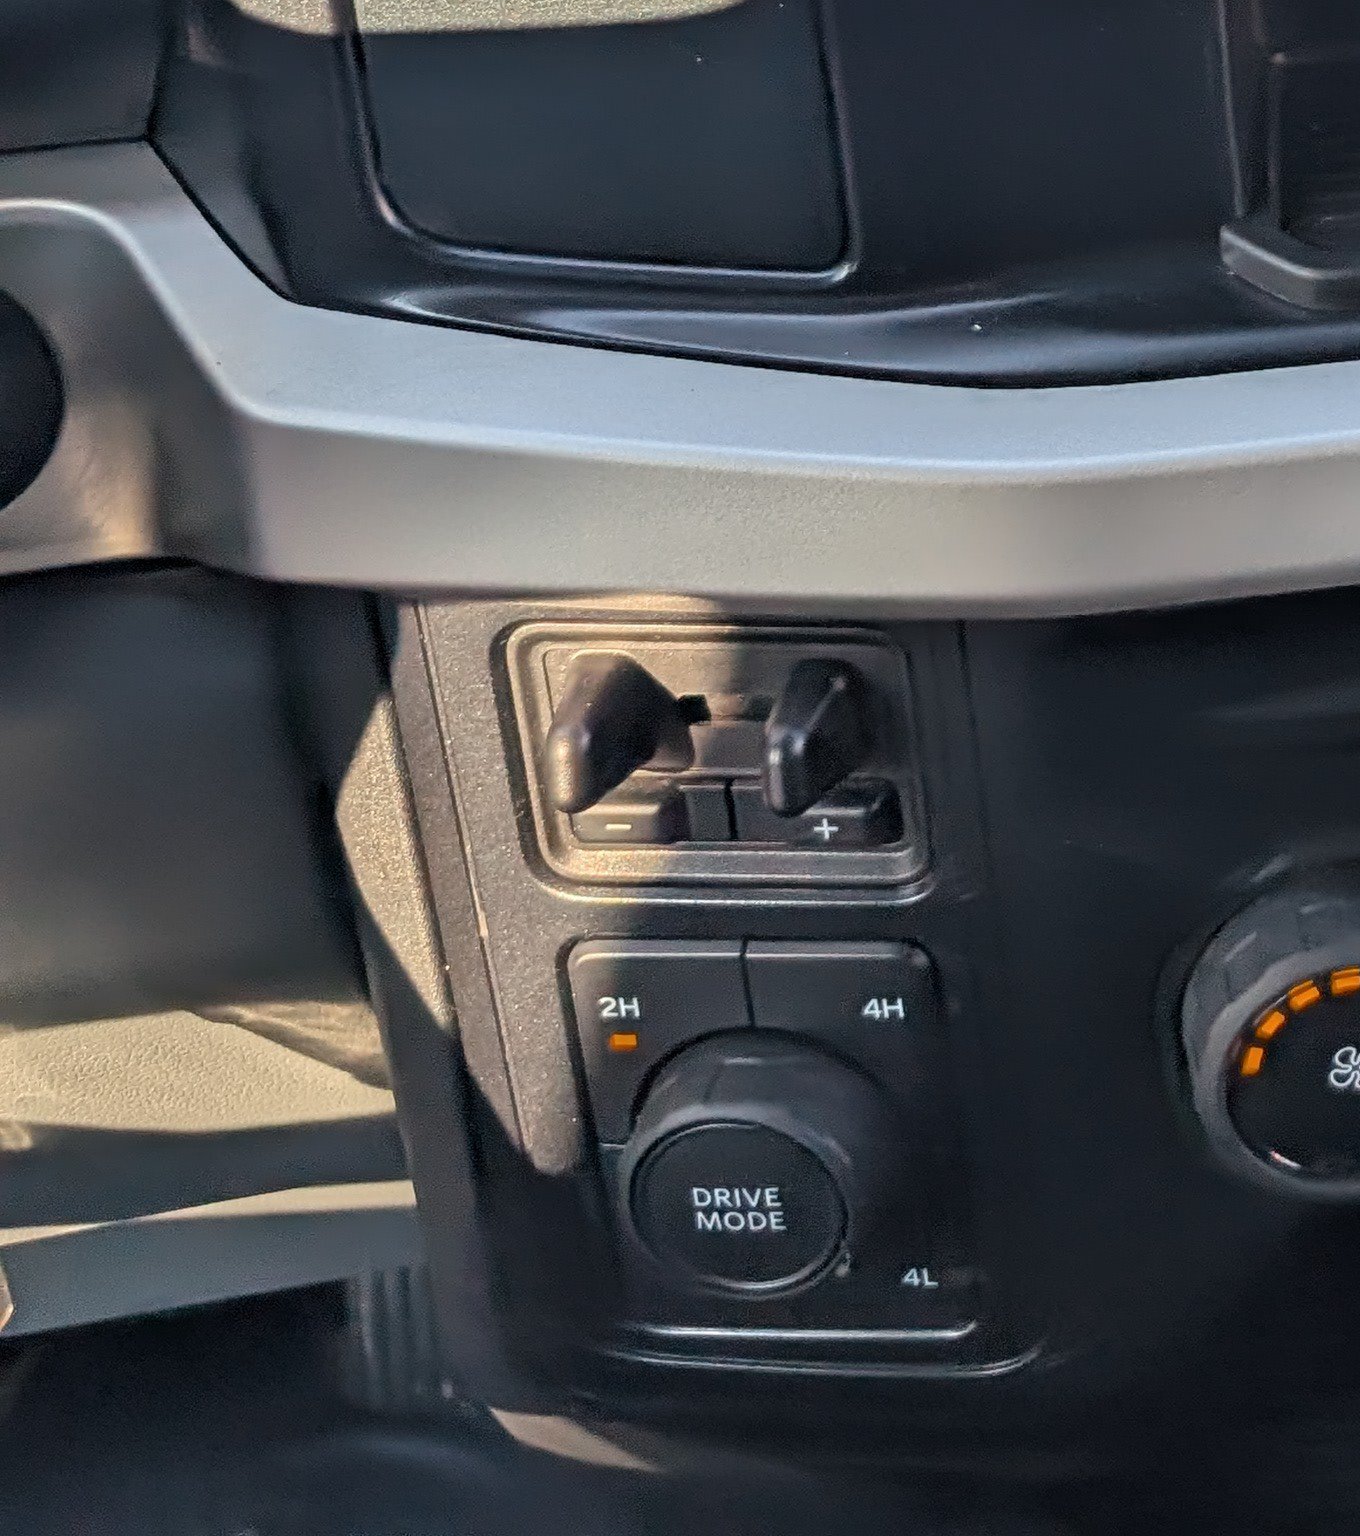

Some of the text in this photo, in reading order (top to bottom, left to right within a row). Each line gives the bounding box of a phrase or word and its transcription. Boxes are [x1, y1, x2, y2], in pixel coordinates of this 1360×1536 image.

[599, 998, 640, 1019] 2H
[861, 997, 904, 1020] 4H
[692, 1187, 783, 1208] DRIVE
[696, 1211, 788, 1232] MODE
[903, 1268, 939, 1289] 4L
